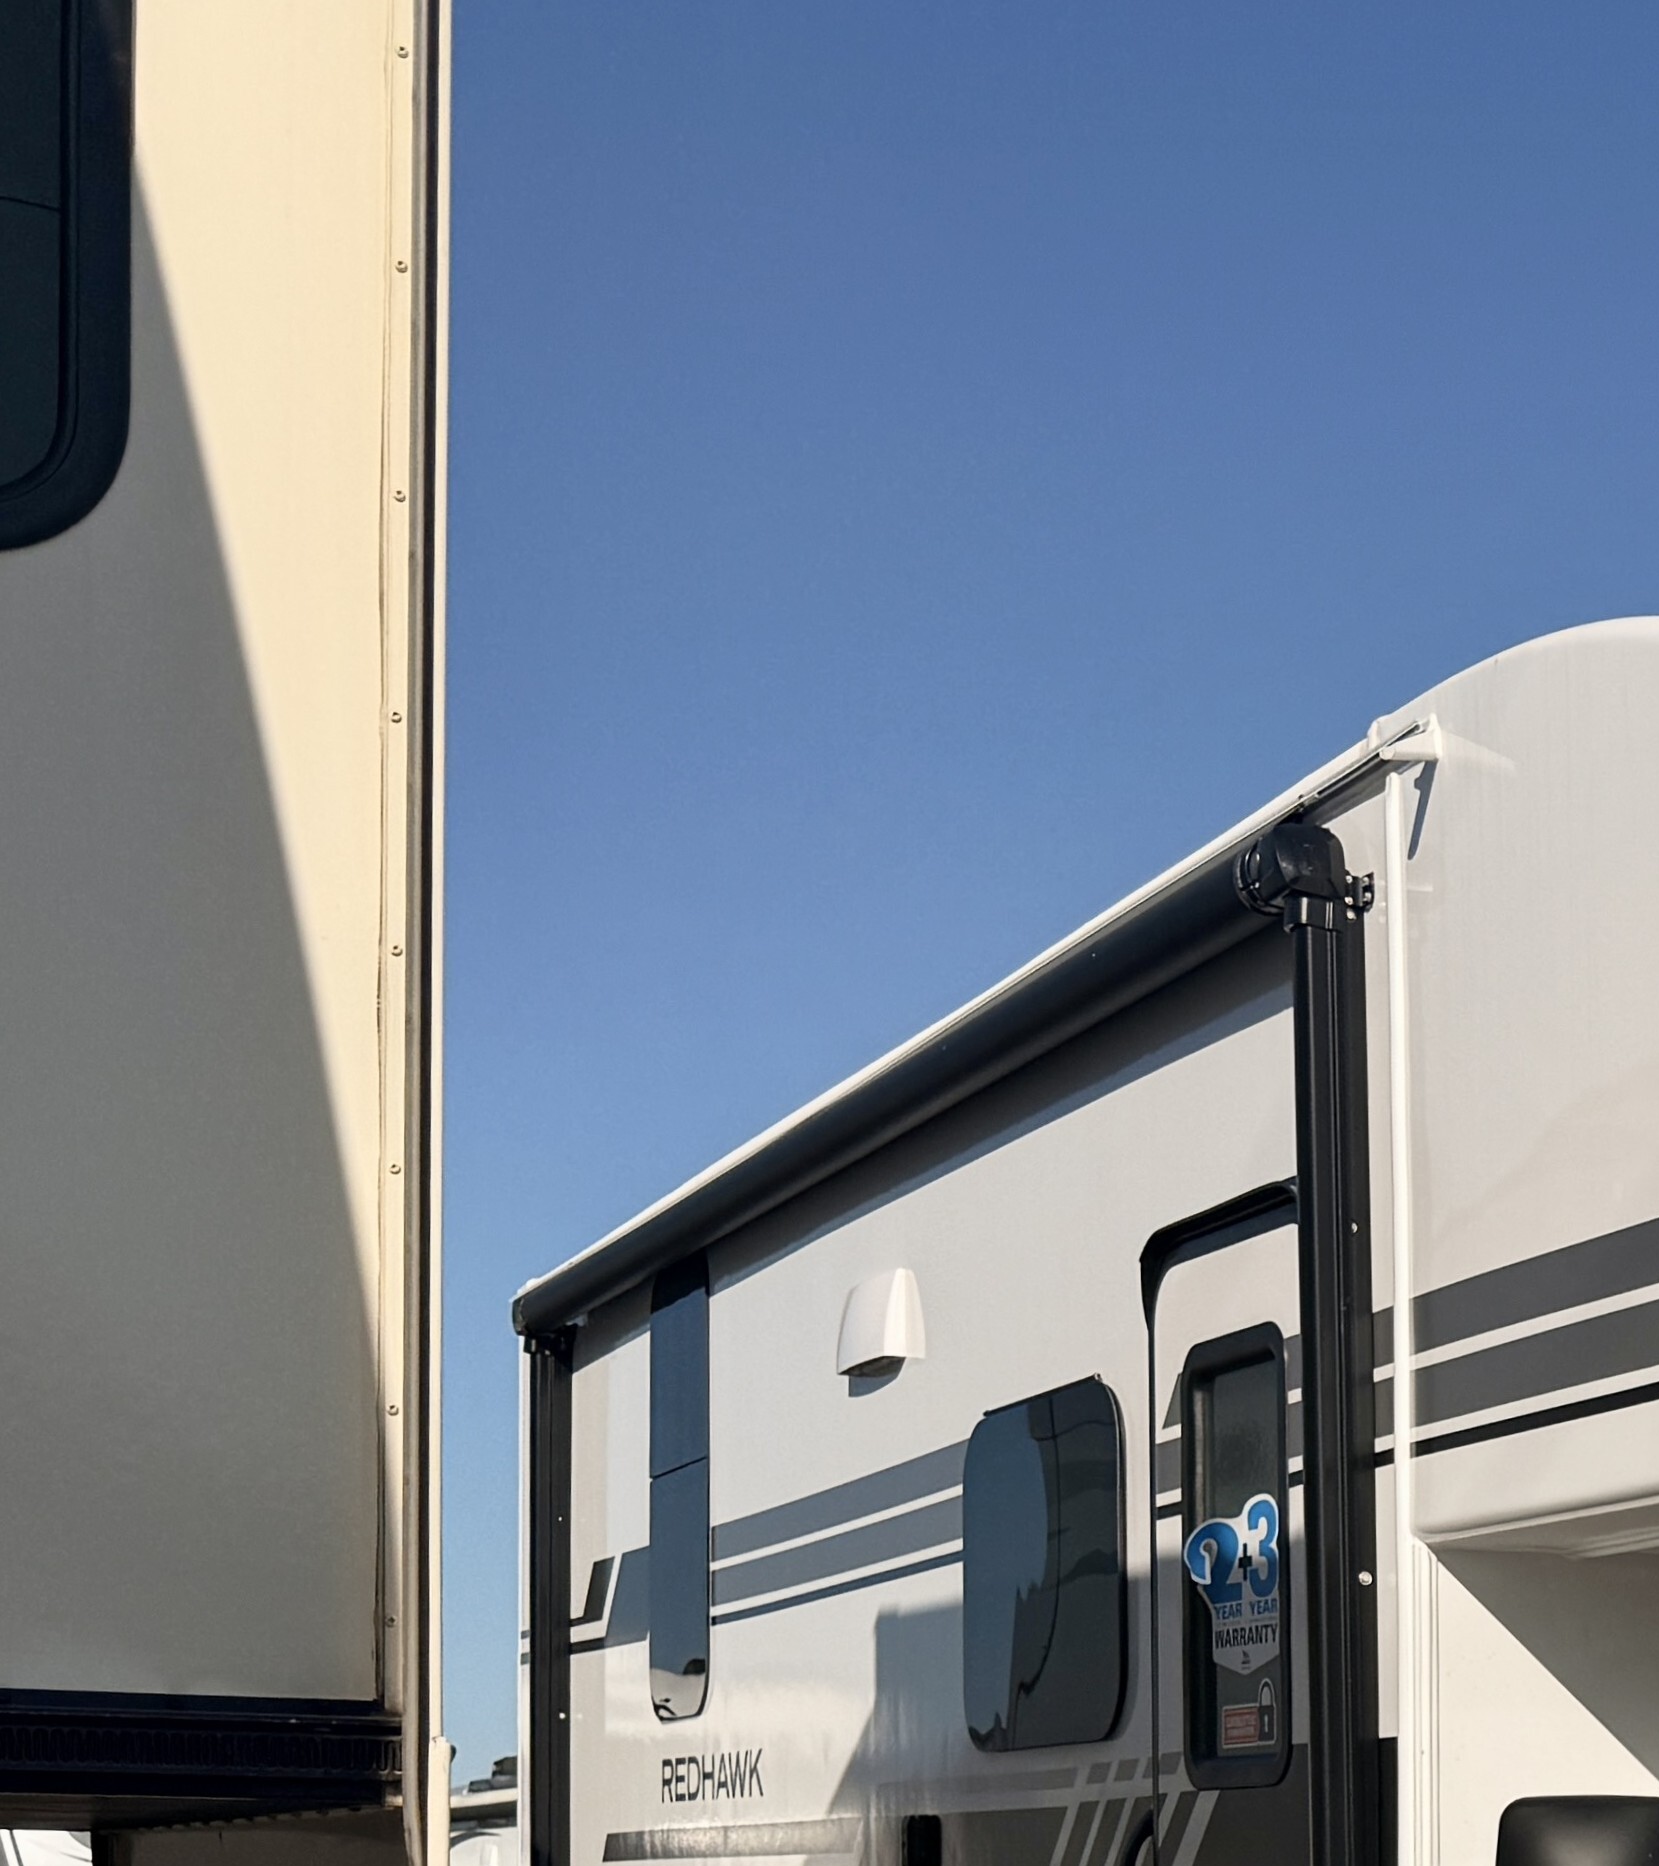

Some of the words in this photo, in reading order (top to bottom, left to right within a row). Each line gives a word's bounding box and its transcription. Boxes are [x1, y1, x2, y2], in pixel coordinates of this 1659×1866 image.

[1214, 1602, 1242, 1620] YEAR
[1250, 1599, 1277, 1617] YEAR
[1215, 1624, 1278, 1649] WARRANTY
[662, 1748, 764, 1803] REDHAWK
